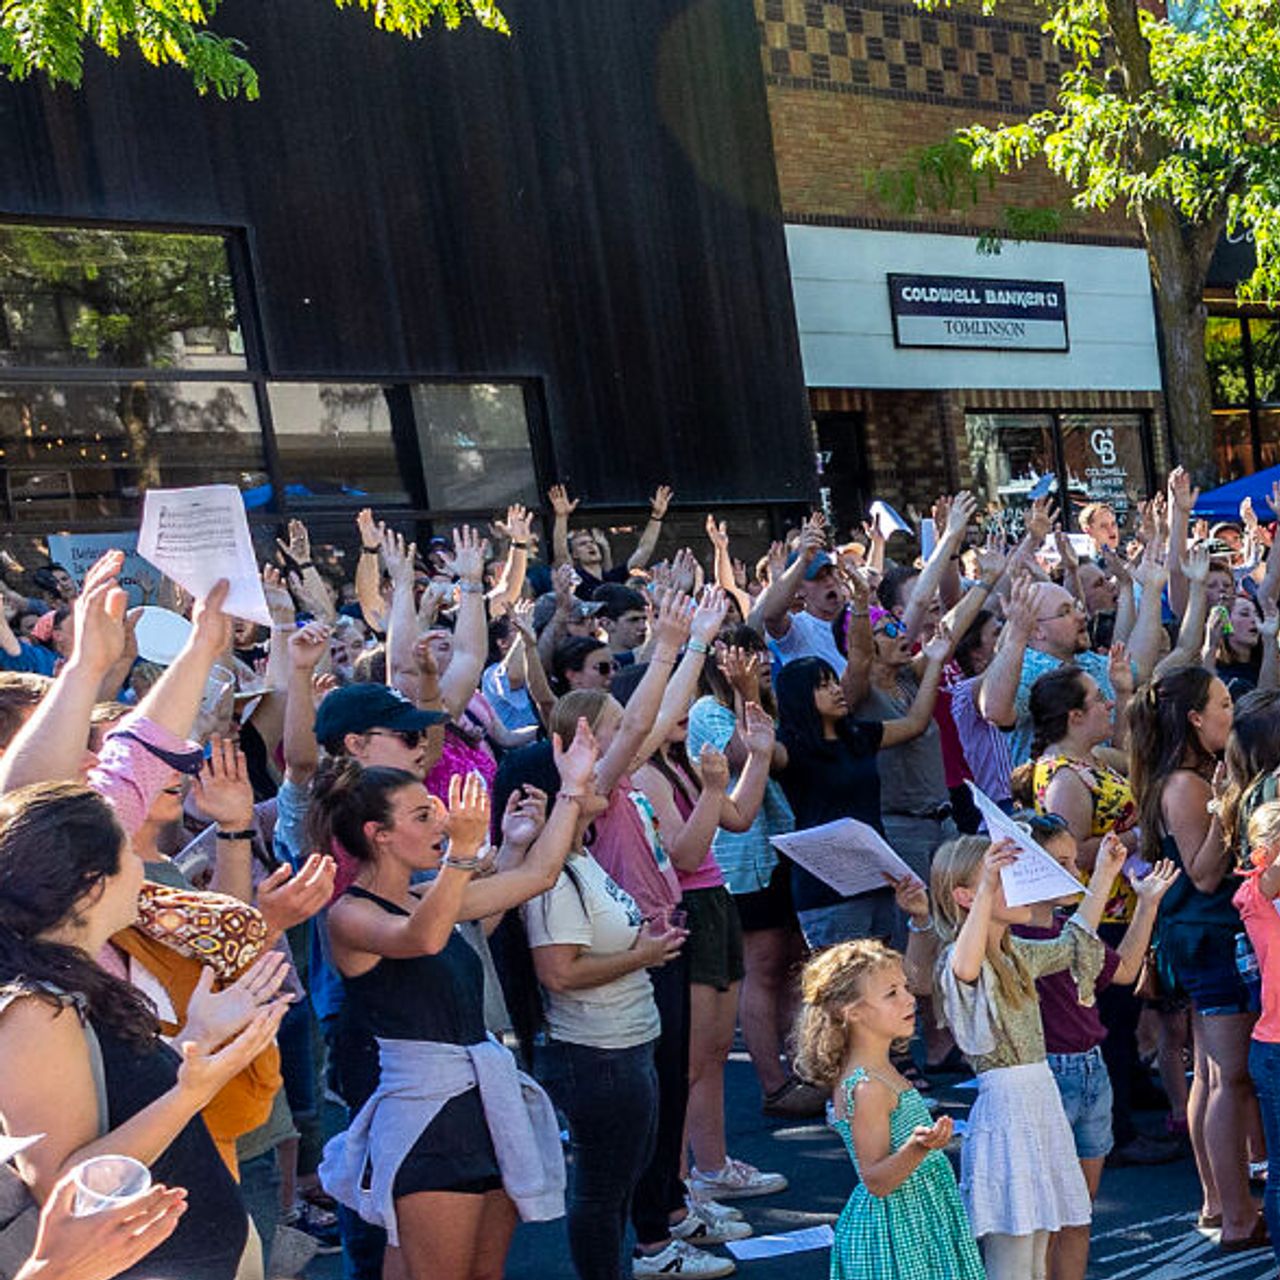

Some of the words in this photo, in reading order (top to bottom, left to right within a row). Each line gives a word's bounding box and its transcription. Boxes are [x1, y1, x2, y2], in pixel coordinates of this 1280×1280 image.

[901, 286, 981, 304] COLDWELL
[985, 290, 1045, 308] BANKER
[943, 319, 1026, 337] TOMLINSON
